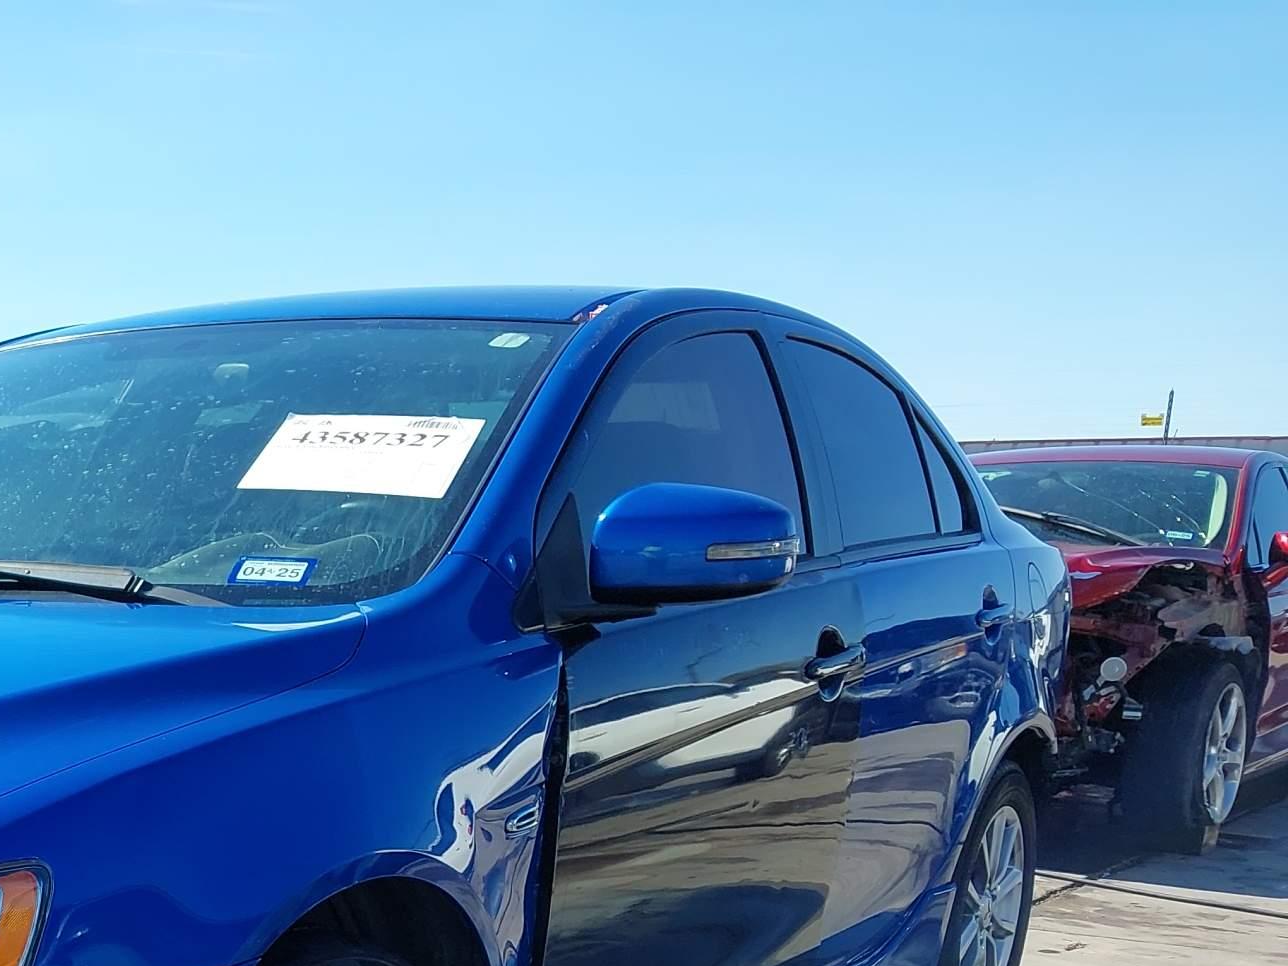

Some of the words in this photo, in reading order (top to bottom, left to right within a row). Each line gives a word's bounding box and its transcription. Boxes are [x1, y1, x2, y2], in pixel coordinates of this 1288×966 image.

[291, 430, 451, 448] 43587327
[242, 566, 266, 577] 04
[275, 567, 302, 578] 25
